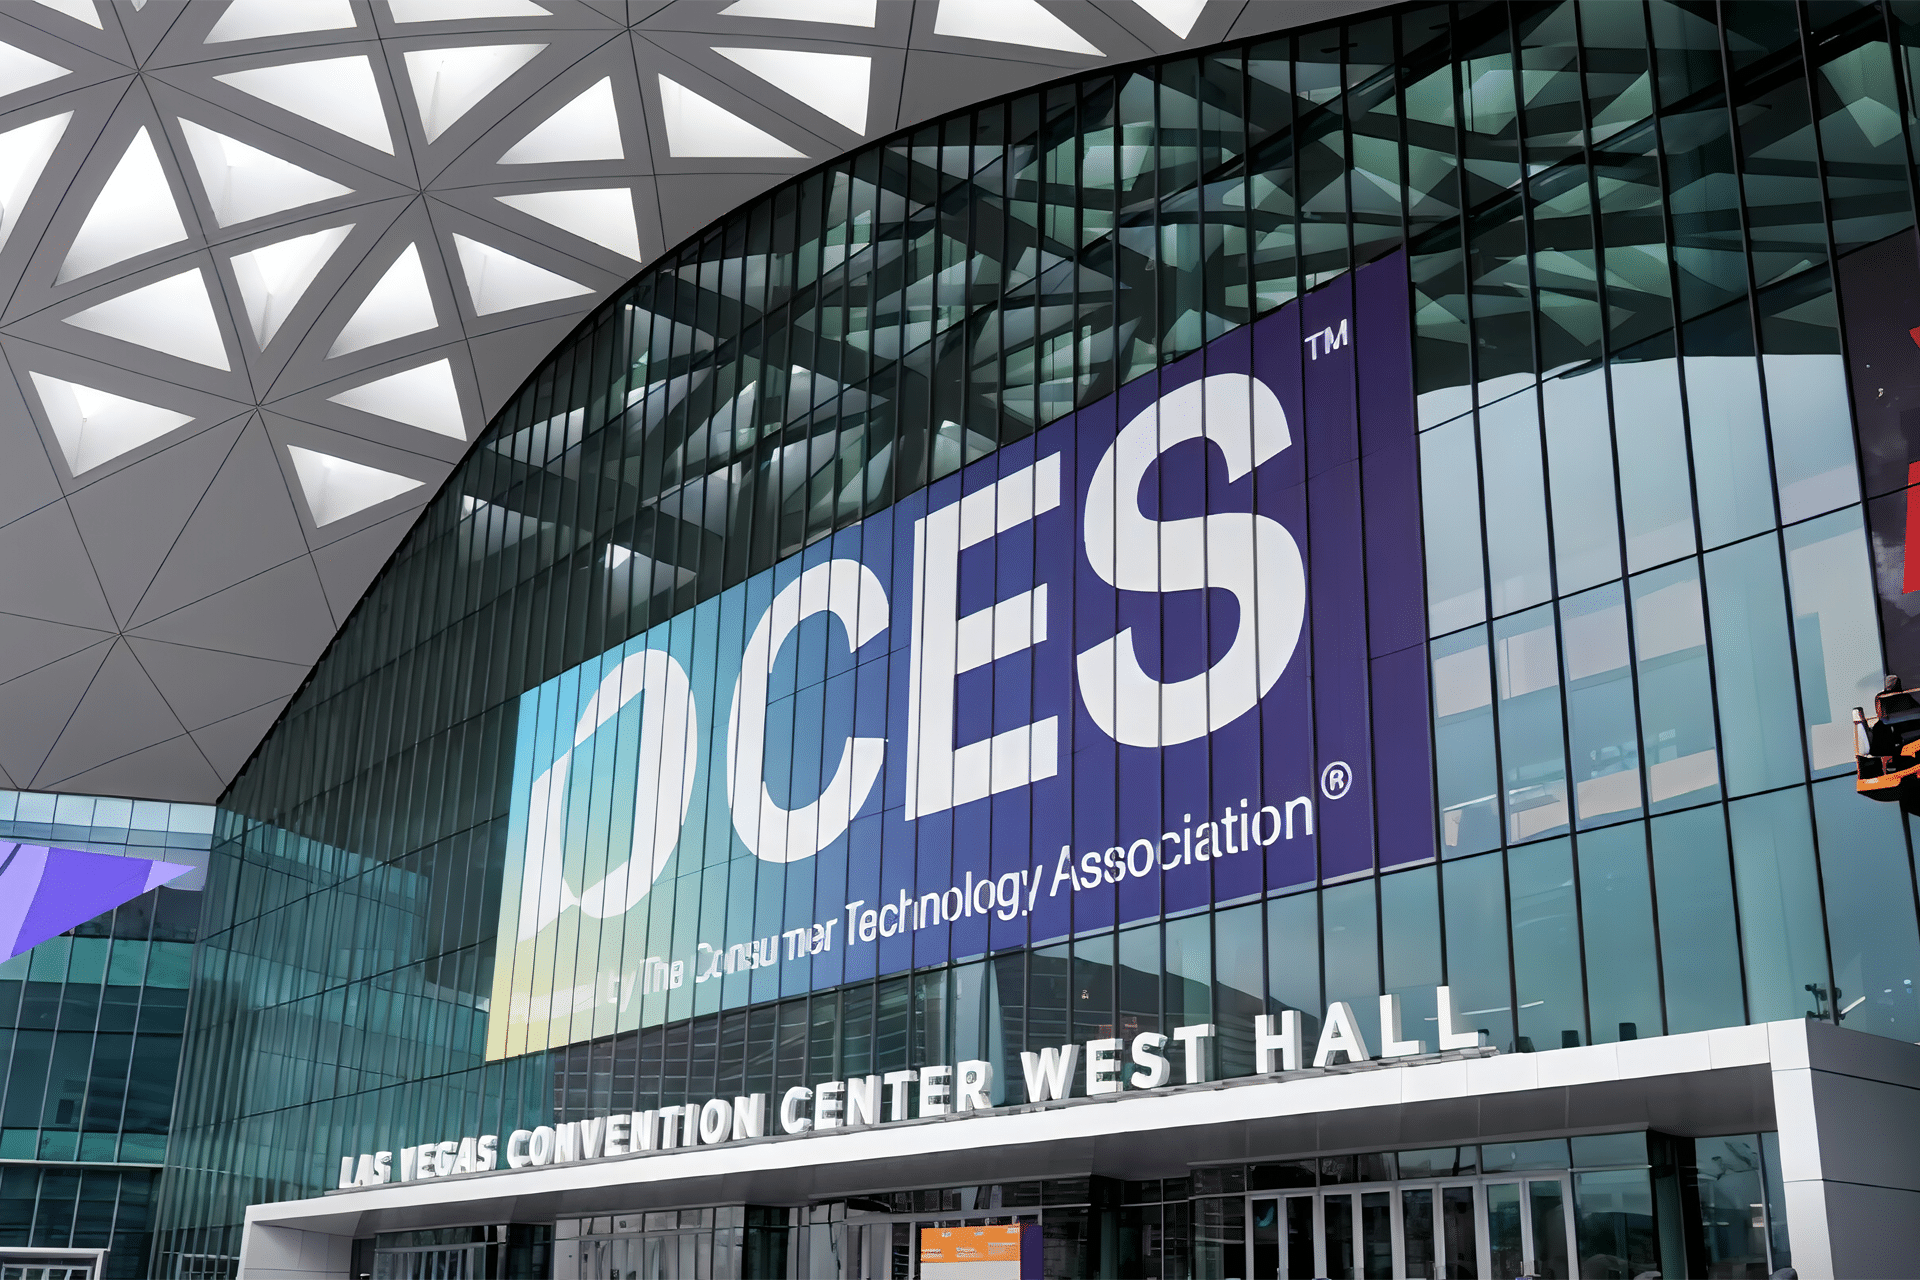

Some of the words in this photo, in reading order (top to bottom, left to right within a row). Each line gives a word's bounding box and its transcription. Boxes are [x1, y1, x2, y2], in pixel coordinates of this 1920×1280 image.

[844, 864, 1043, 946] Technology
[339, 1150, 393, 1189] LAS
[401, 1134, 498, 1182] VEGAS
[506, 1092, 766, 1169] CONVENTION
[780, 1060, 993, 1135] CENTER
[1020, 1022, 1216, 1103] WEST
[1255, 985, 1488, 1074] HALL
